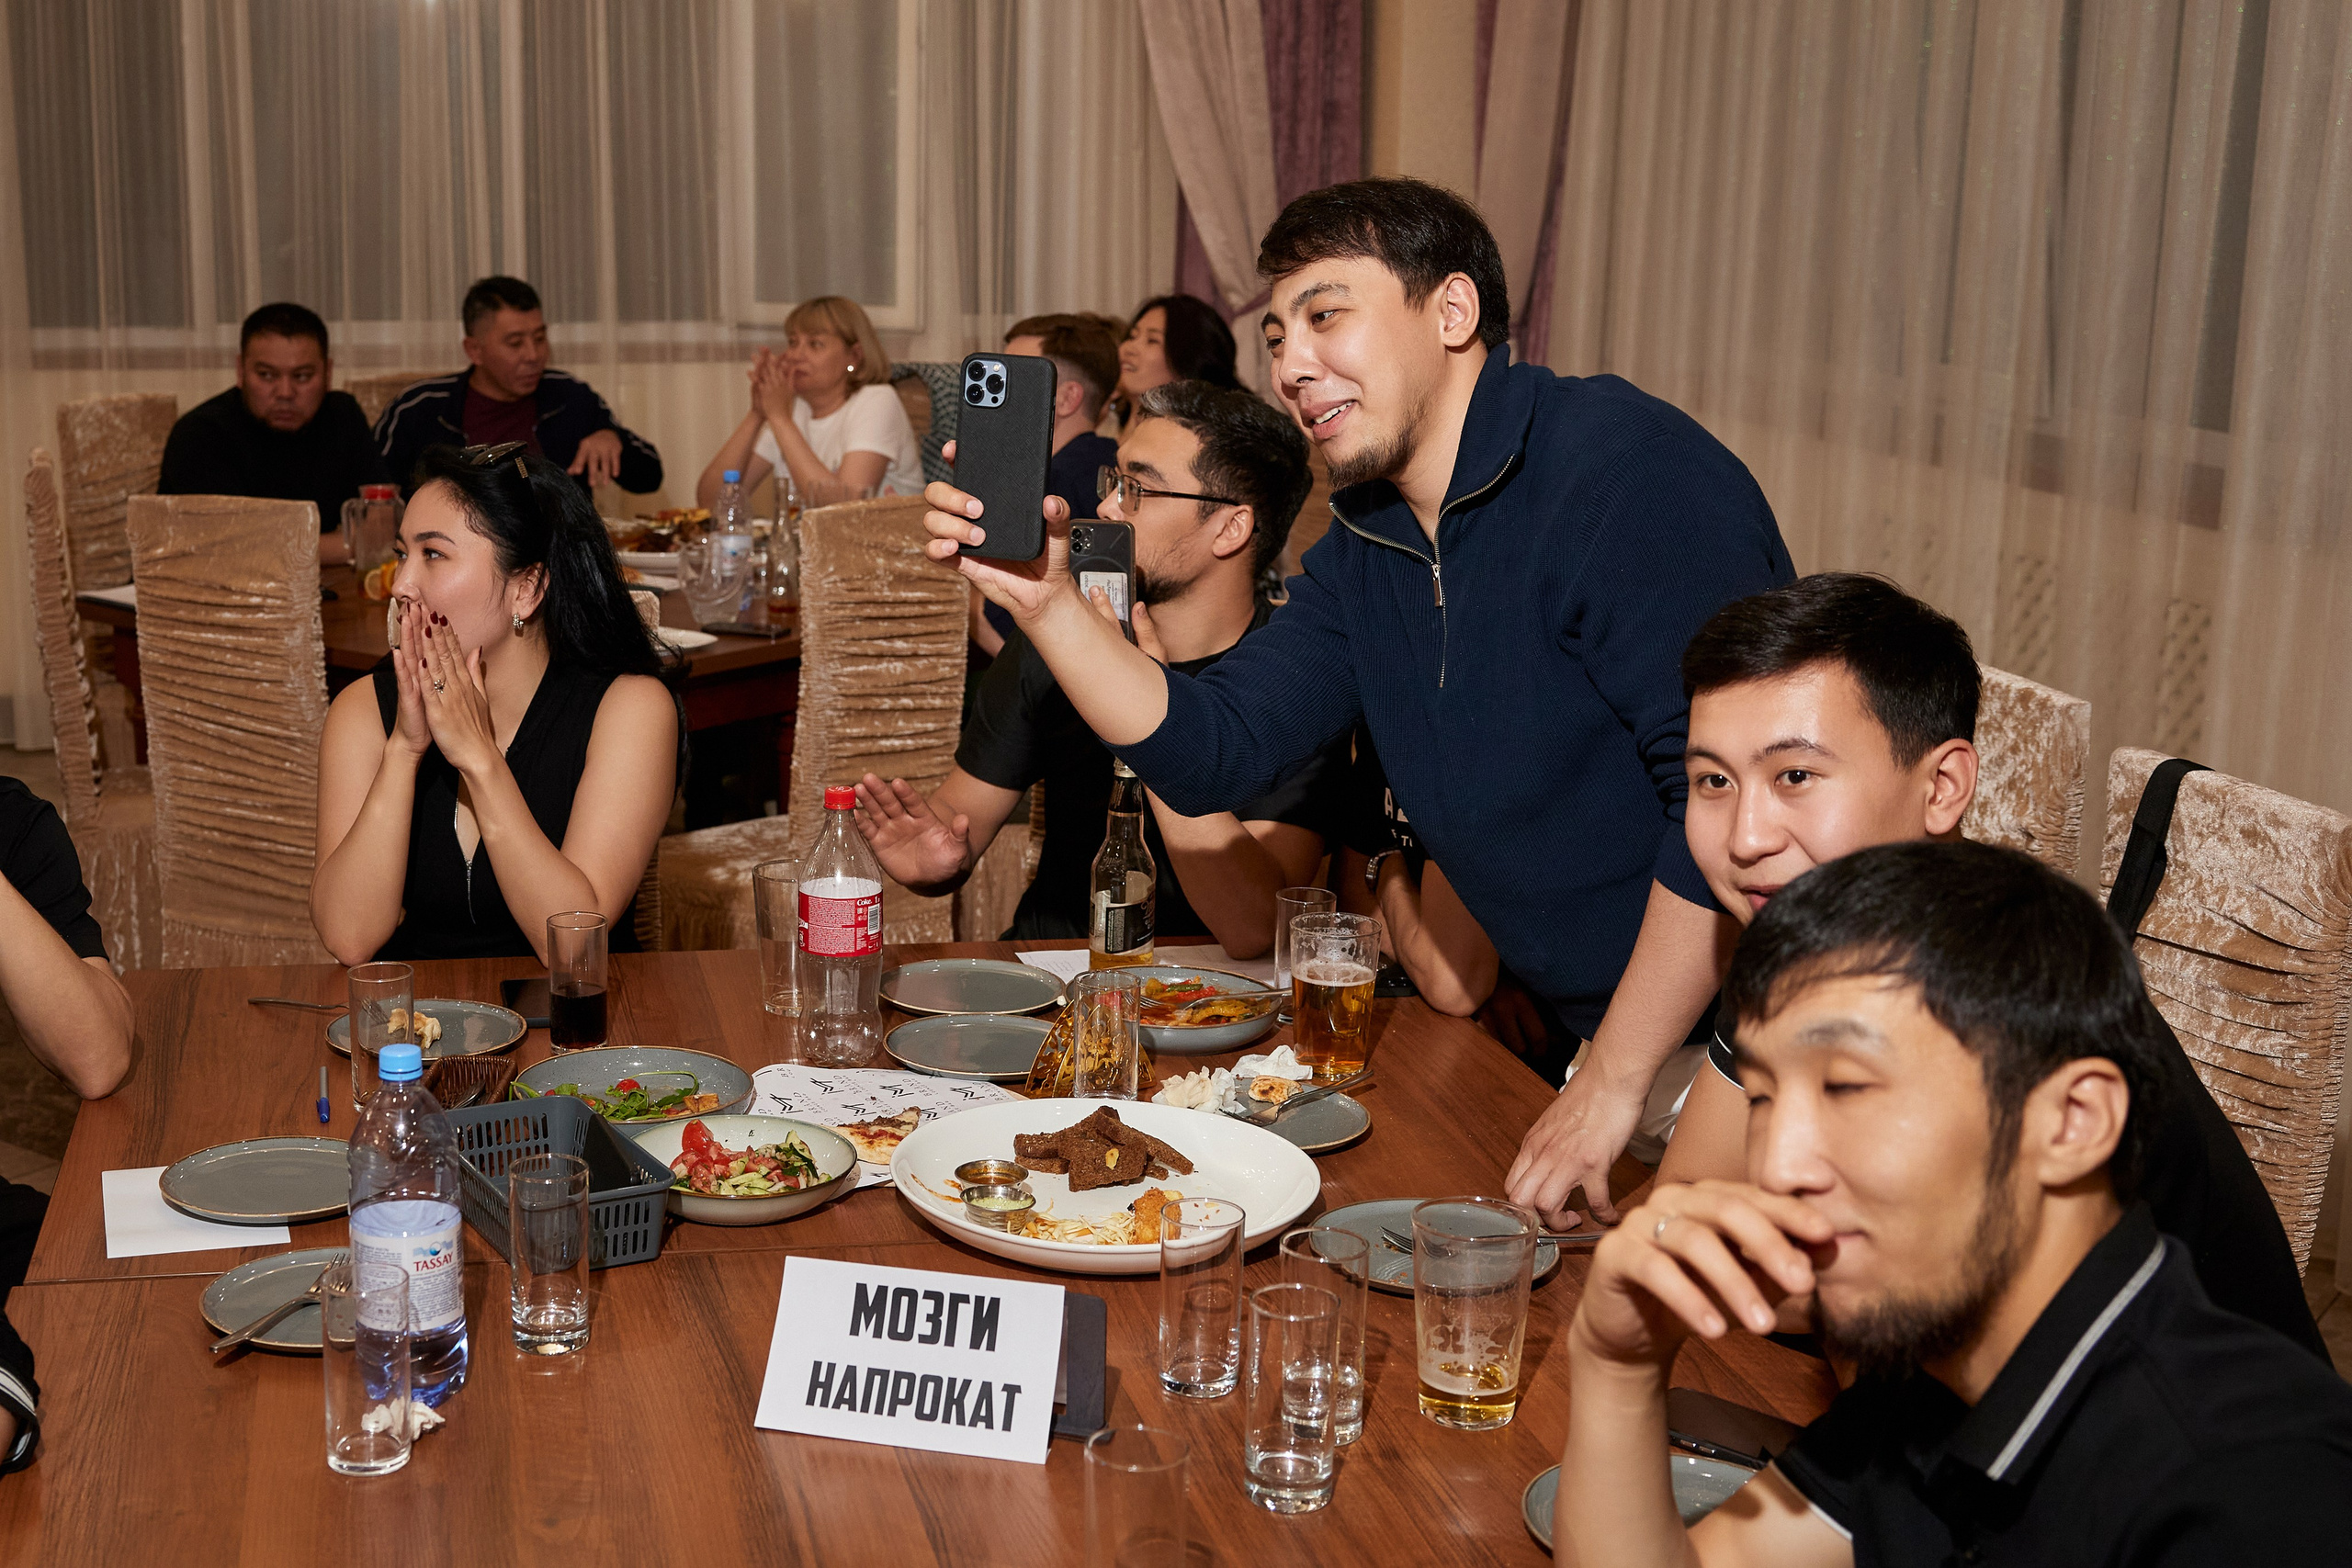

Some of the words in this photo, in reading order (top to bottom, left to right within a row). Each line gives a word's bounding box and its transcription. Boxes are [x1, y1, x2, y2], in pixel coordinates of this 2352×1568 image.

[413, 1251, 454, 1272] TASSAY
[849, 1282, 1001, 1352] МОЗГИ
[805, 1360, 1023, 1433] НАПРОКАТ
